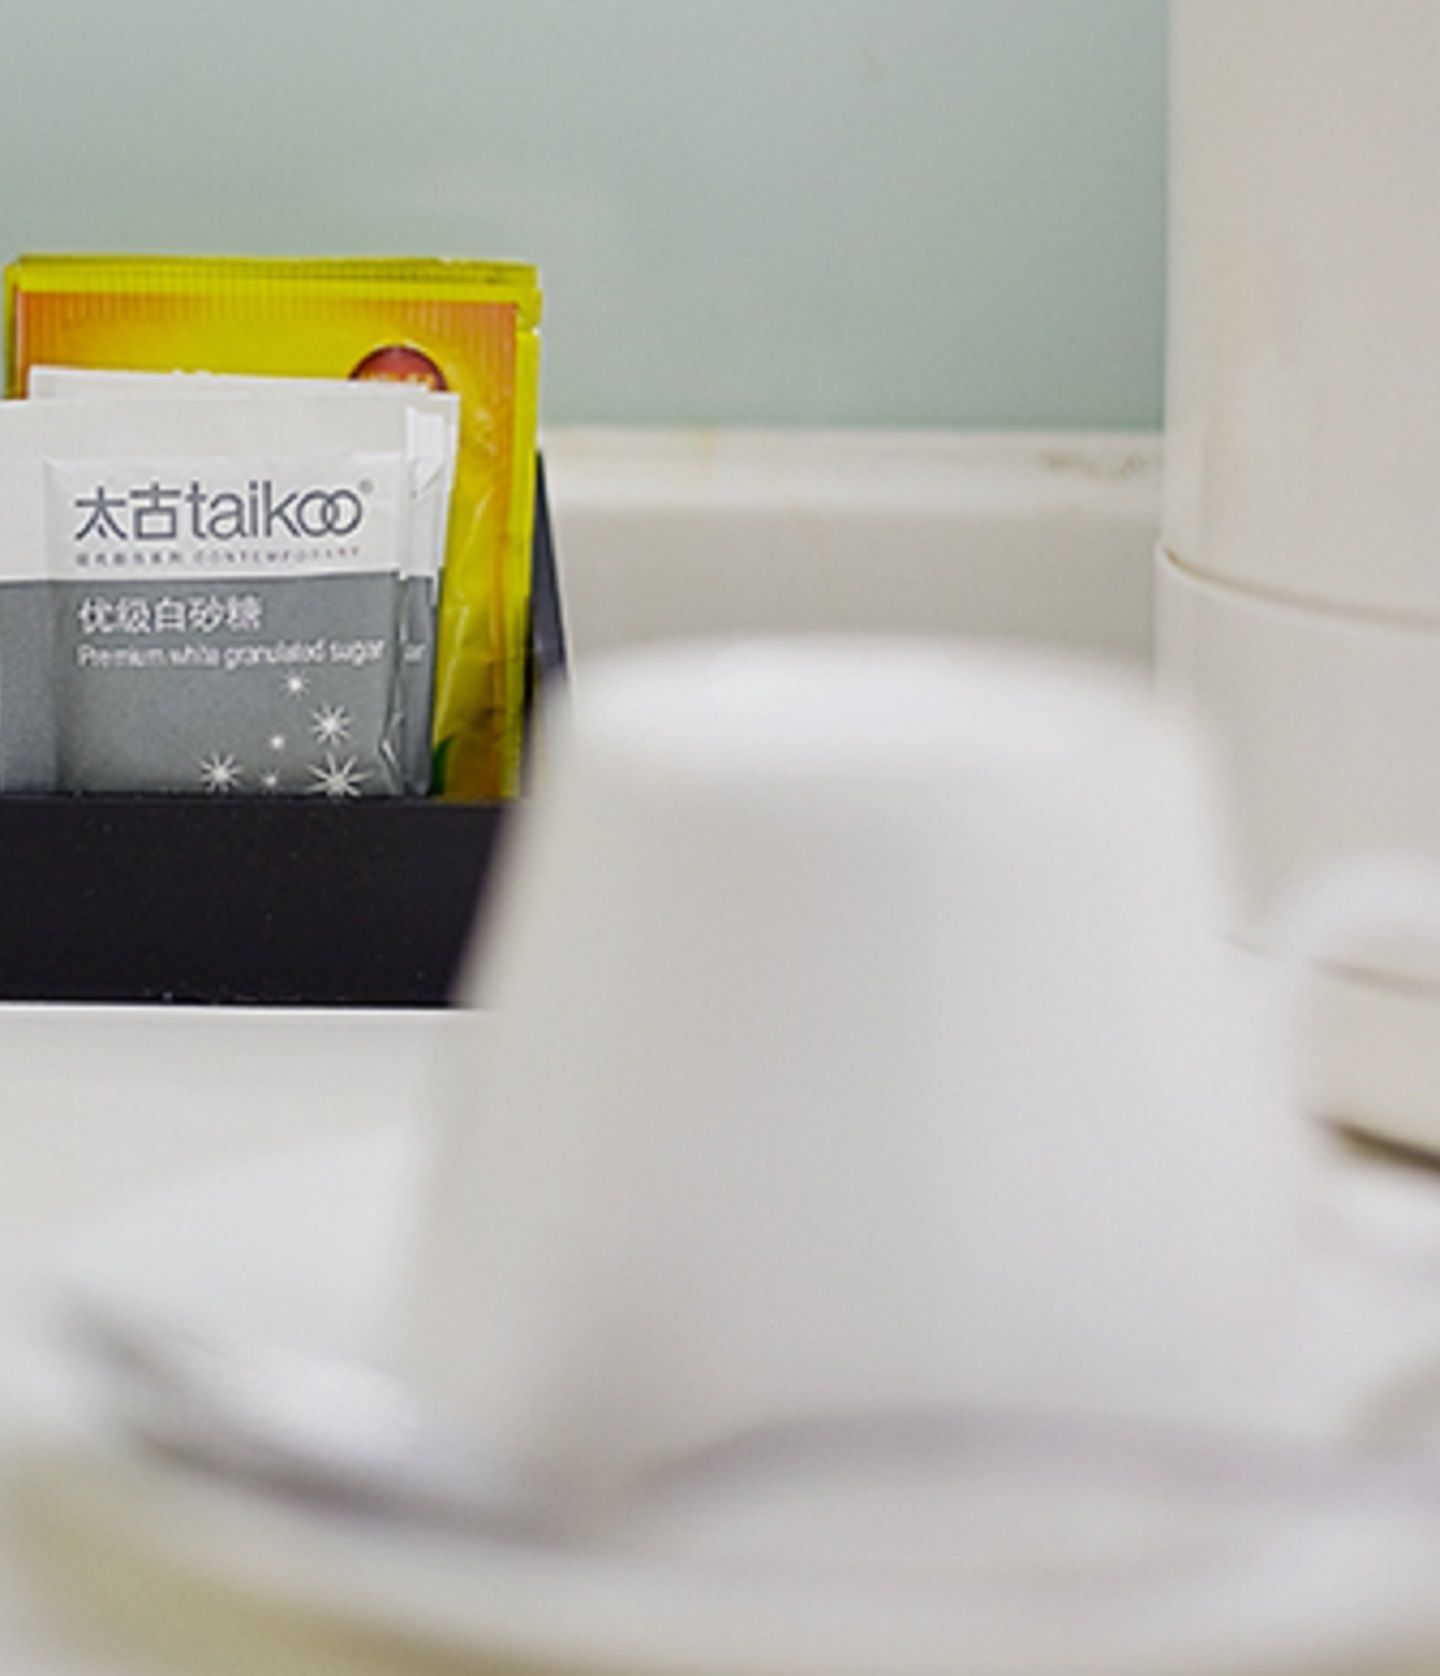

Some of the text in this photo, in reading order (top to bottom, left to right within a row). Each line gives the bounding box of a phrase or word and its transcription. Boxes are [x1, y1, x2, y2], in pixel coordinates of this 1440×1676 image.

[78, 596, 262, 634] 优级白砂糖
[76, 644, 165, 667] Premium
[330, 639, 385, 667] sugar
